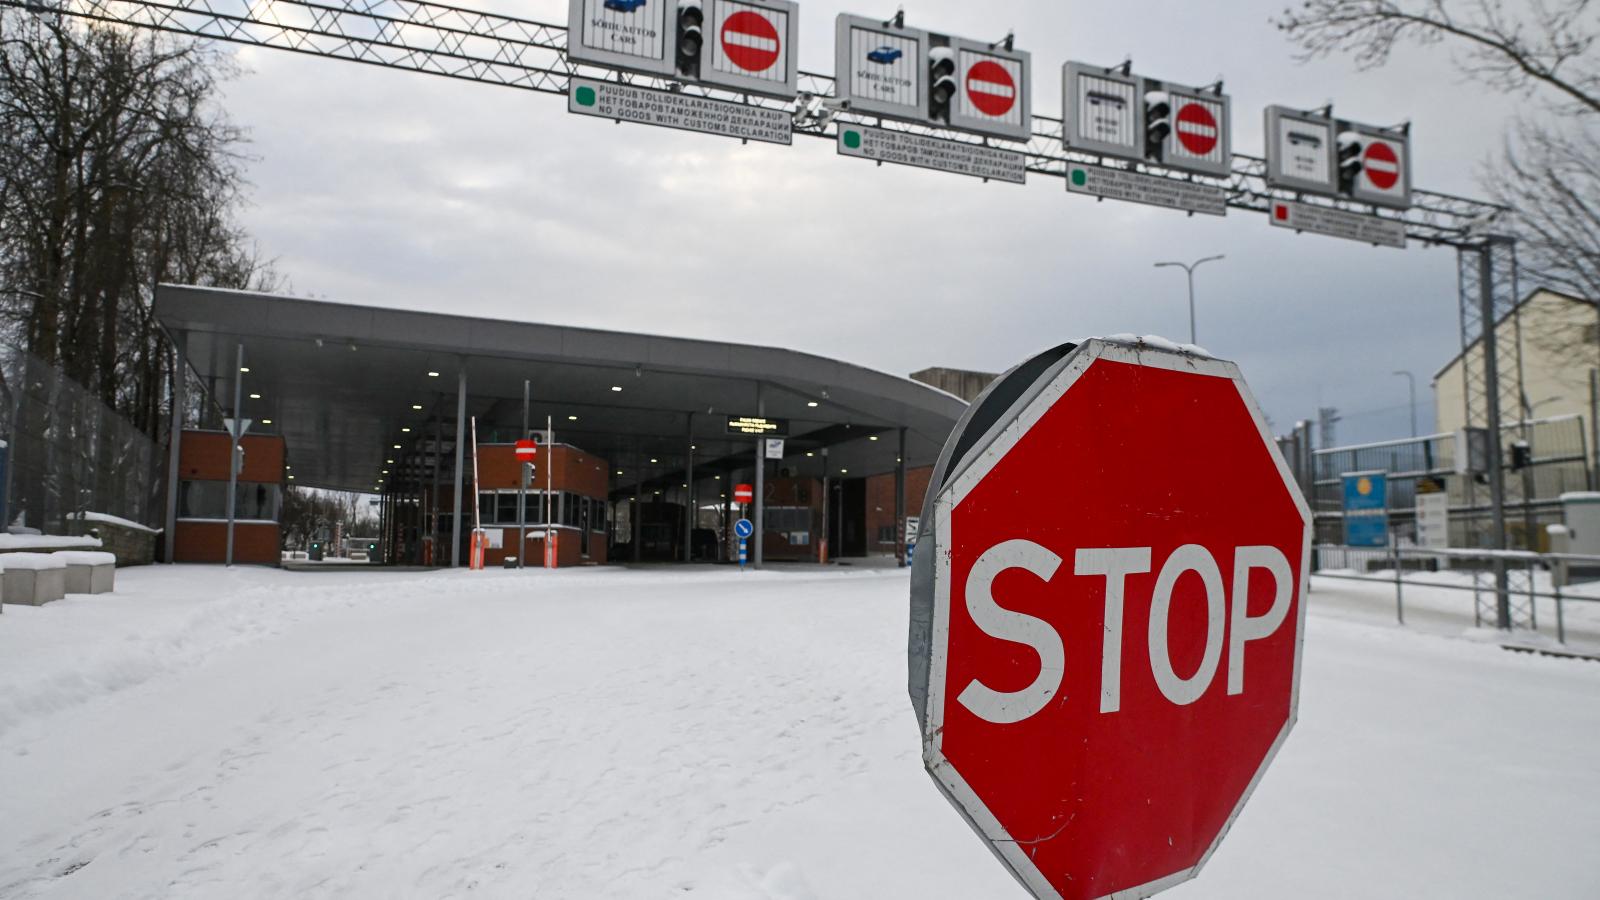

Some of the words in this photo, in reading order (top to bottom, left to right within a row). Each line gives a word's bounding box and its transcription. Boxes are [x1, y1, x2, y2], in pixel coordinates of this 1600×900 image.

[611, 33, 636, 45] CARS
[599, 85, 638, 98] PUUDUB
[640, 92, 757, 117] TOLLIDEKLARATSIOONIGA
[759, 112, 783, 121] KAUP
[599, 106, 613, 115] NO
[618, 108, 651, 121] GOODS
[656, 114, 679, 125] WITH
[683, 118, 727, 132] CUSTOMS
[729, 125, 789, 141] DECLARATION
[730, 115, 789, 131] ДЕКЛАРАЦИИ
[957, 539, 1293, 723] STOP
